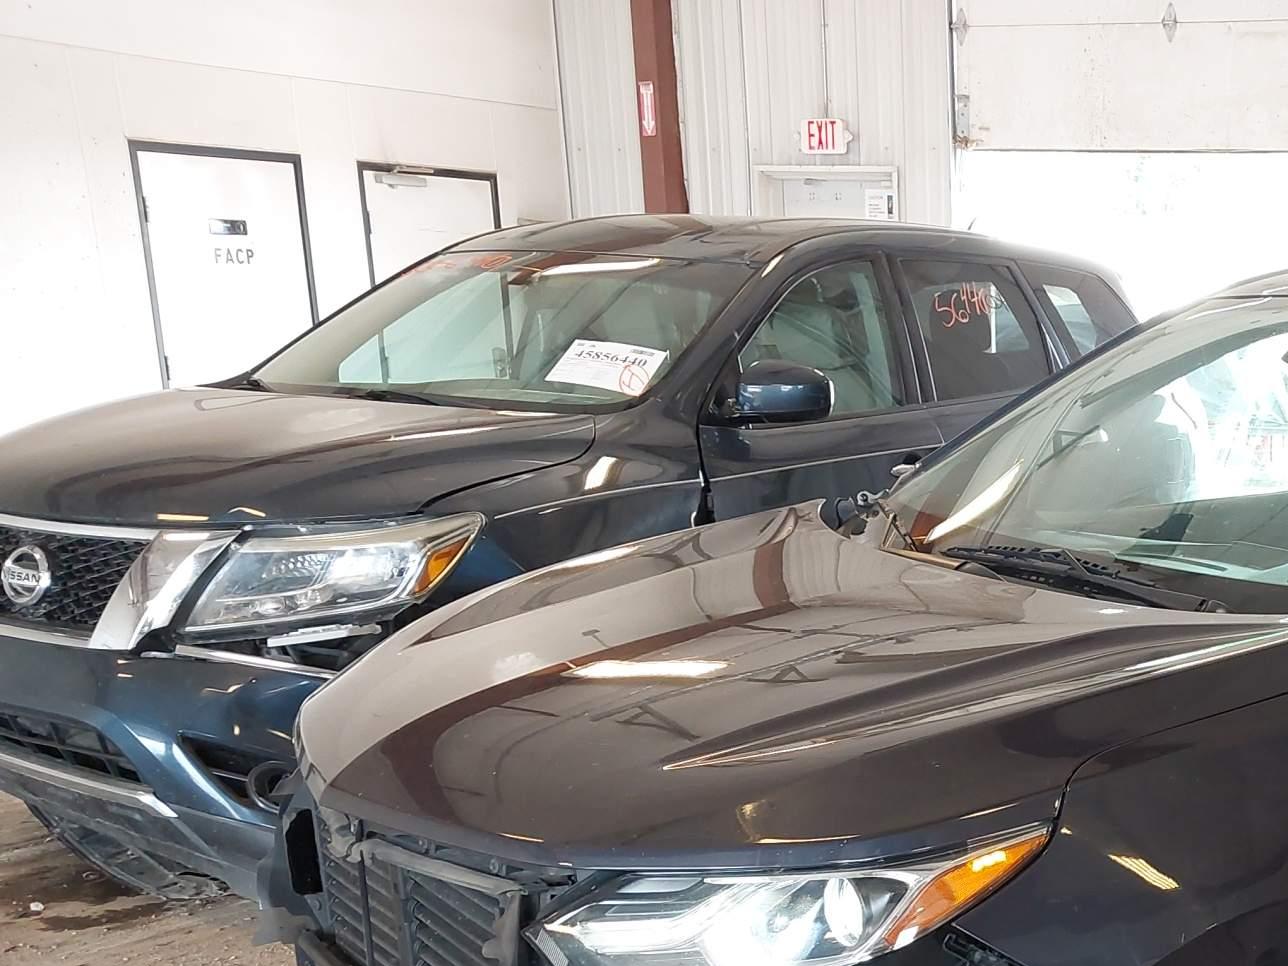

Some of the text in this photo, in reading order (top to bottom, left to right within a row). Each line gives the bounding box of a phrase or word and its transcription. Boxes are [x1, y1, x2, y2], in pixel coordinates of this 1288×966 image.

[807, 120, 837, 151] EXIT
[214, 247, 254, 265] FACP
[574, 349, 649, 367] 45856440
